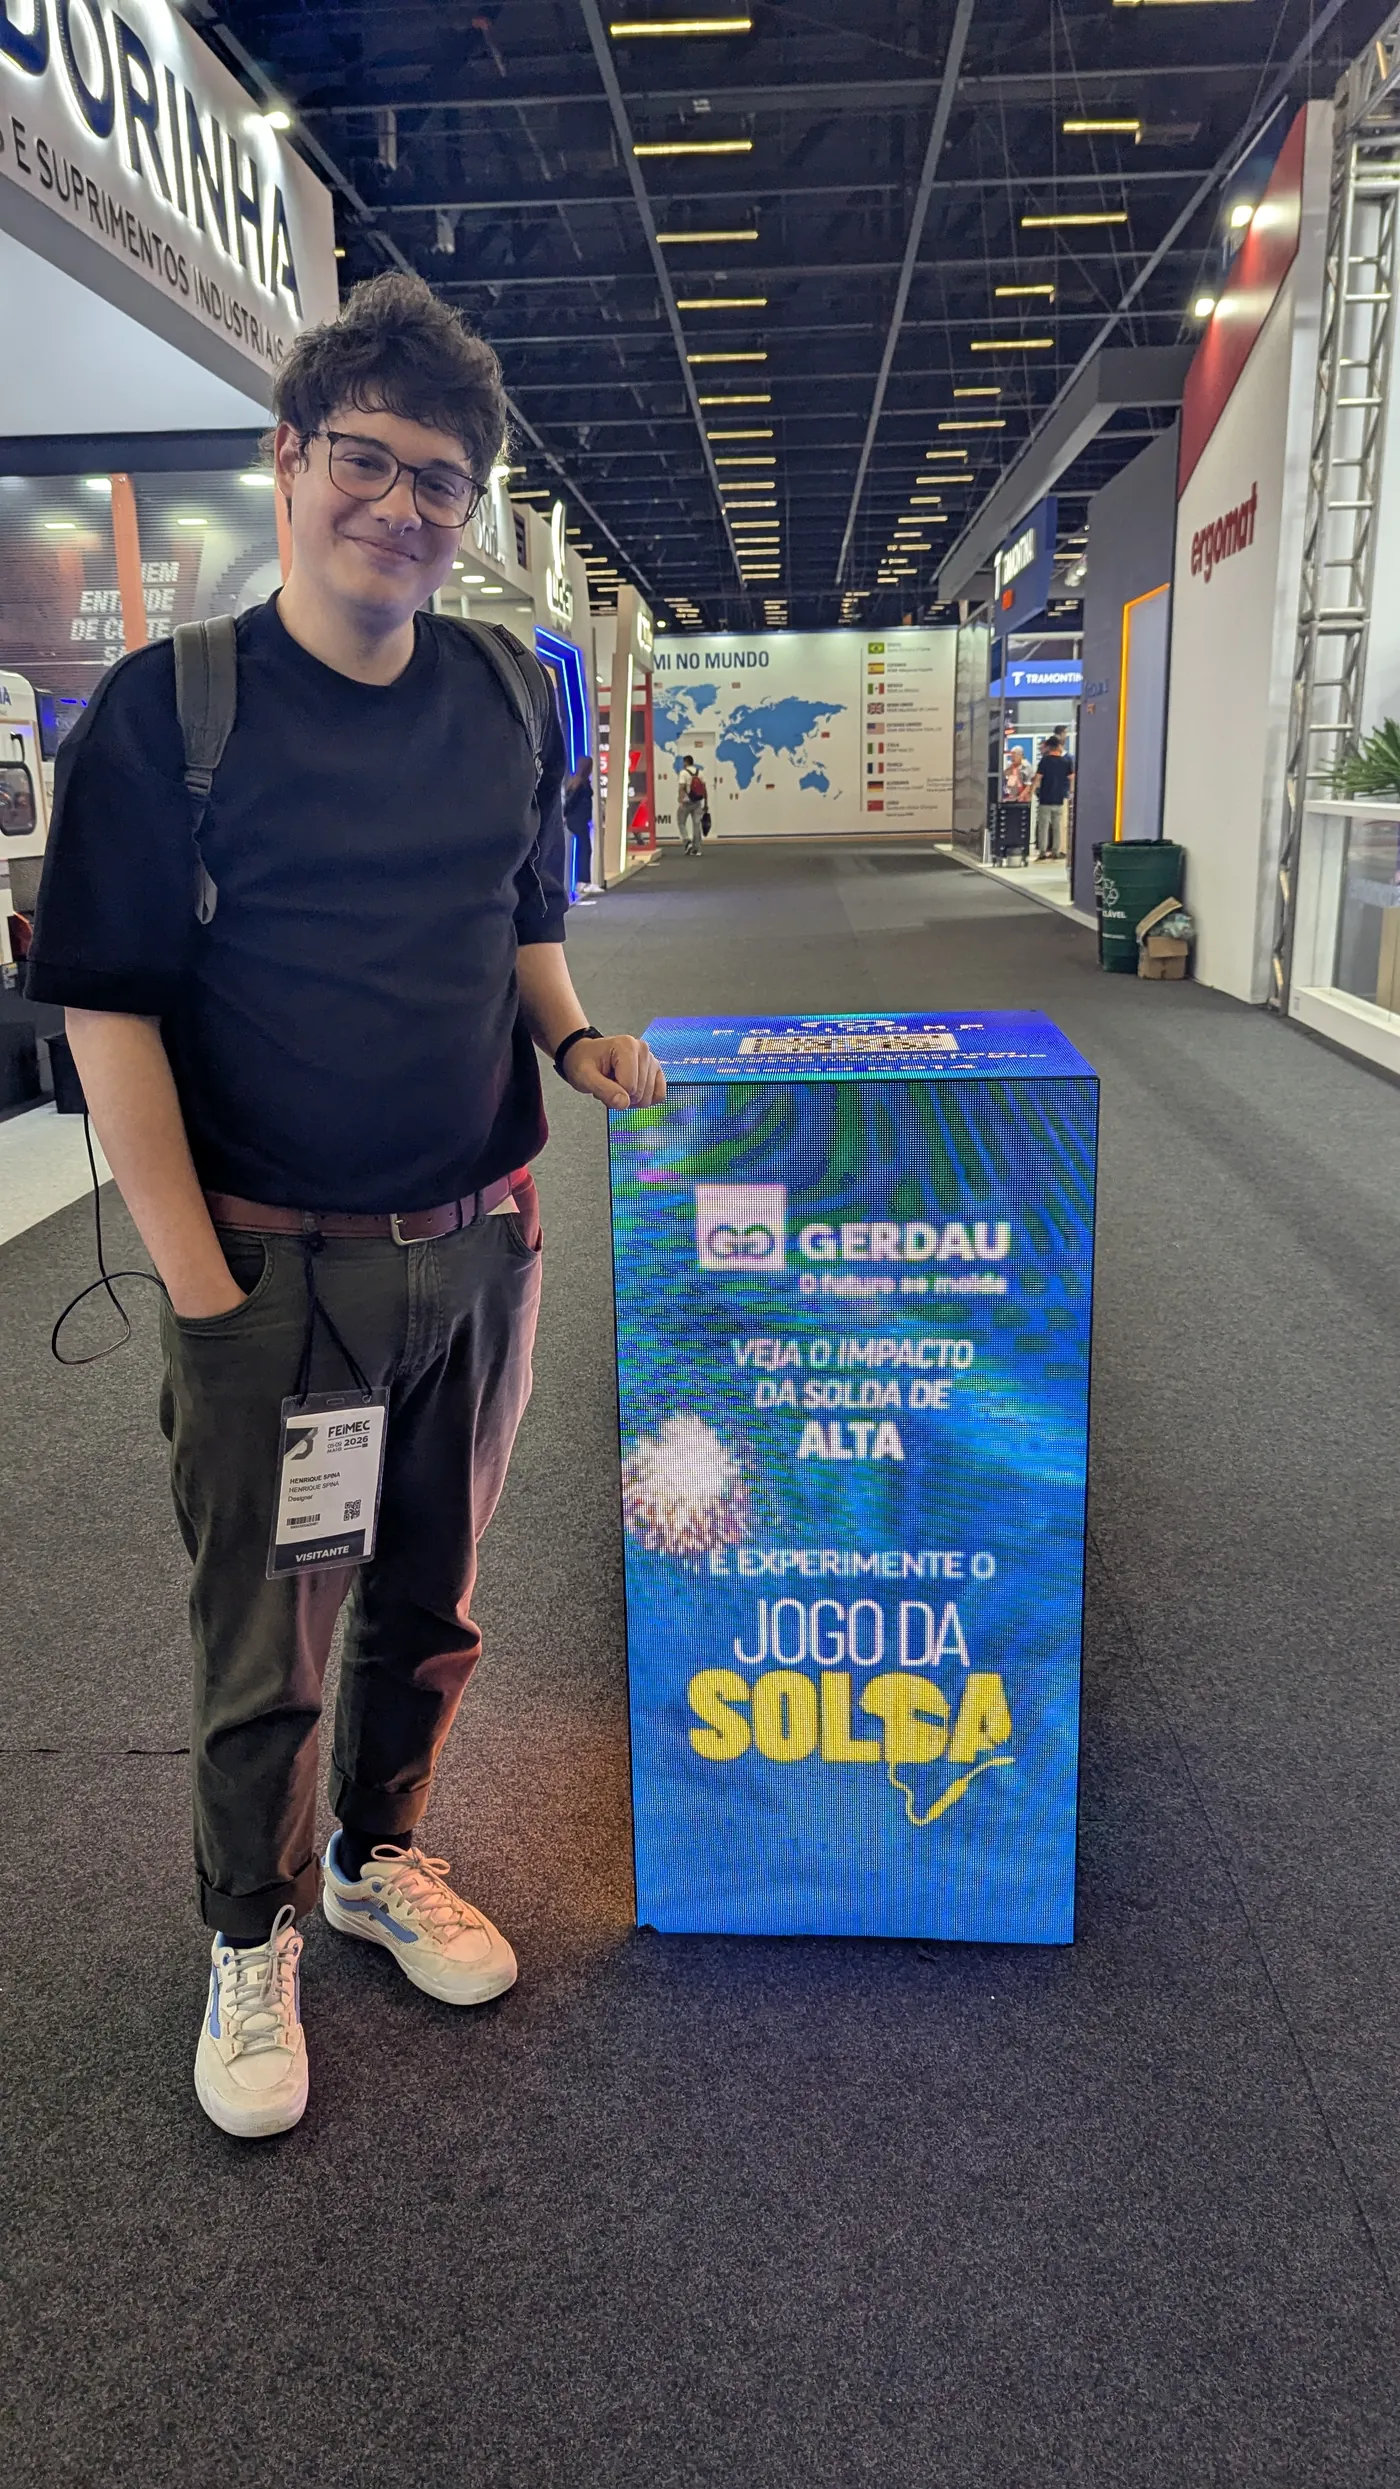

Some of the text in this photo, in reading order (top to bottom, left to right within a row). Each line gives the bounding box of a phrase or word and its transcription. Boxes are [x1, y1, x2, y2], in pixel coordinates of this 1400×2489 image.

[11, 115, 284, 365] E SUPRIMENTOS INDUSTRIAIS
[1190, 481, 1257, 584] ergomat
[142, 562, 180, 583] EM
[80, 588, 176, 612] ENTDE
[70, 617, 171, 641] DE CTE
[676, 652, 700, 670] NO
[705, 651, 769, 669] MUNDO
[799, 1222, 1012, 1262] GERDAU
[732, 1339, 974, 1371] VEJA O IMPACTO
[754, 1379, 950, 1409] DA SOLDA DE
[344, 1435, 369, 1447] 2026
[796, 1421, 905, 1461] ALTA
[289, 1480, 340, 1493] HENRIQUE SPINA
[290, 1472, 341, 1485] HENRIQUE SPINA
[288, 1494, 314, 1502] Designer
[295, 1545, 350, 1563] VISITANTE
[737, 1551, 964, 1580] EXPERIMENTE
[974, 1552, 996, 1580] O
[733, 1598, 971, 1668] JOGO DA
